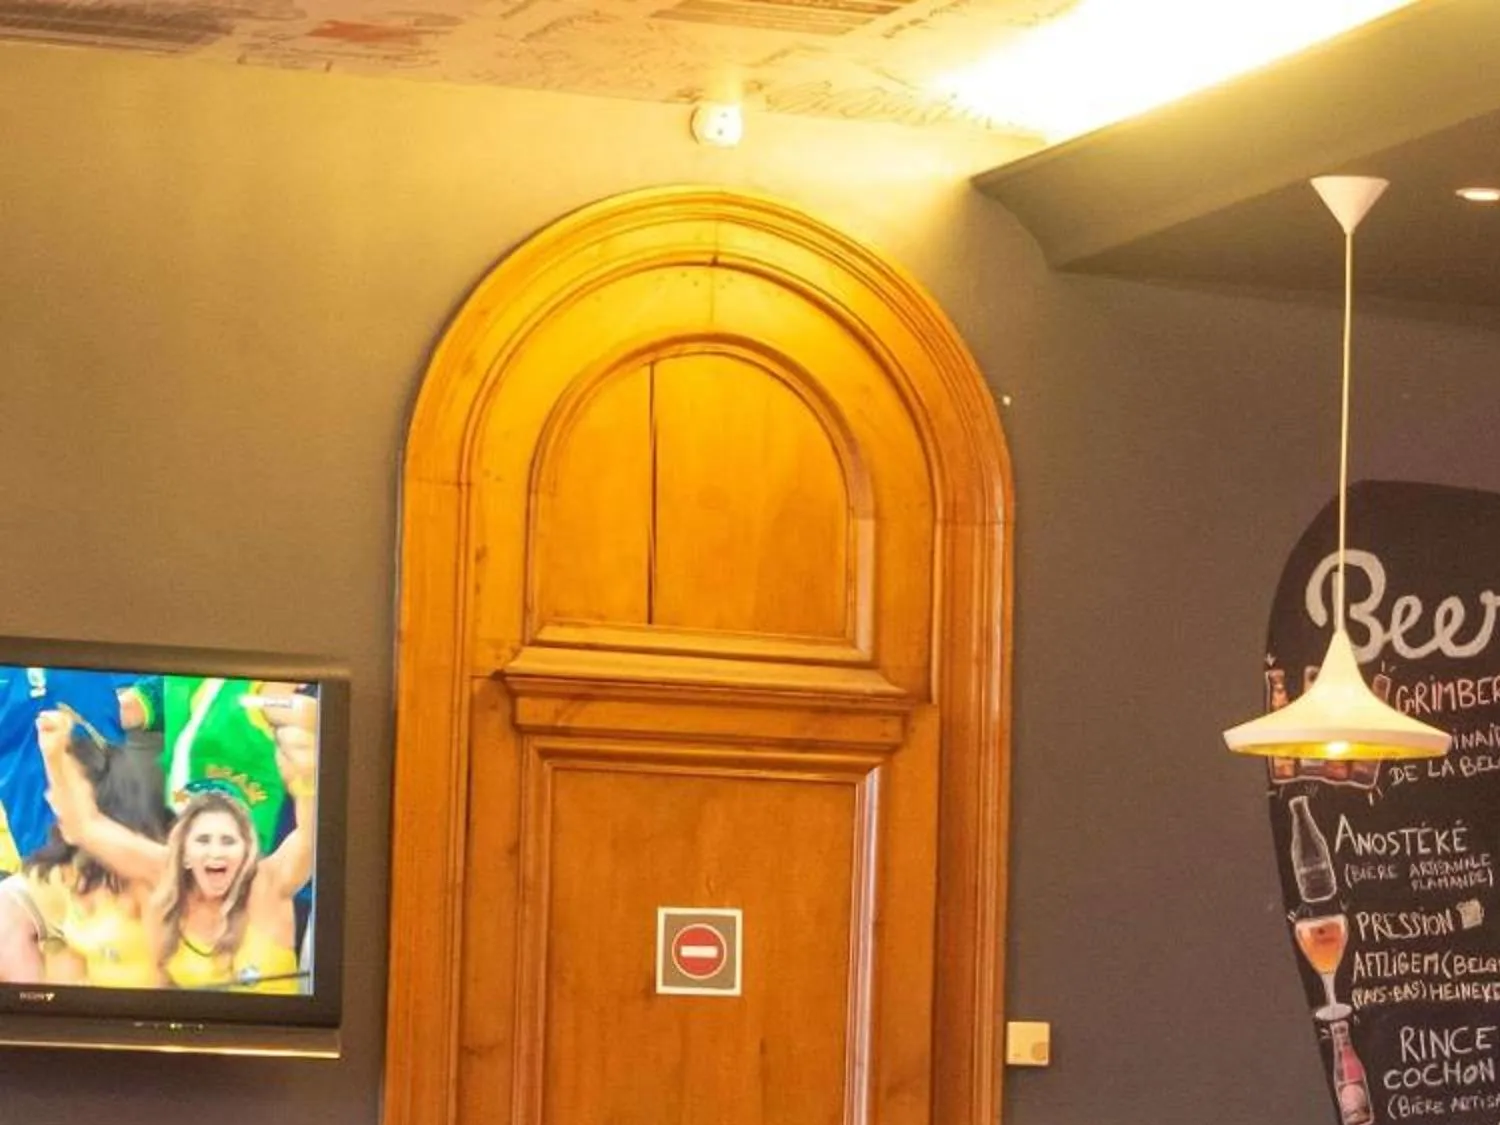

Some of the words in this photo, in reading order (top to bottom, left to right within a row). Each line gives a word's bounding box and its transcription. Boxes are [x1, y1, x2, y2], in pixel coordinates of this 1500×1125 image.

[1388, 764, 1419, 786] DE
[1427, 759, 1455, 778] LA
[1356, 907, 1455, 942] PRESSION
[1400, 1024, 1498, 1063] RINCE
[1383, 1056, 1495, 1090] COCHON
